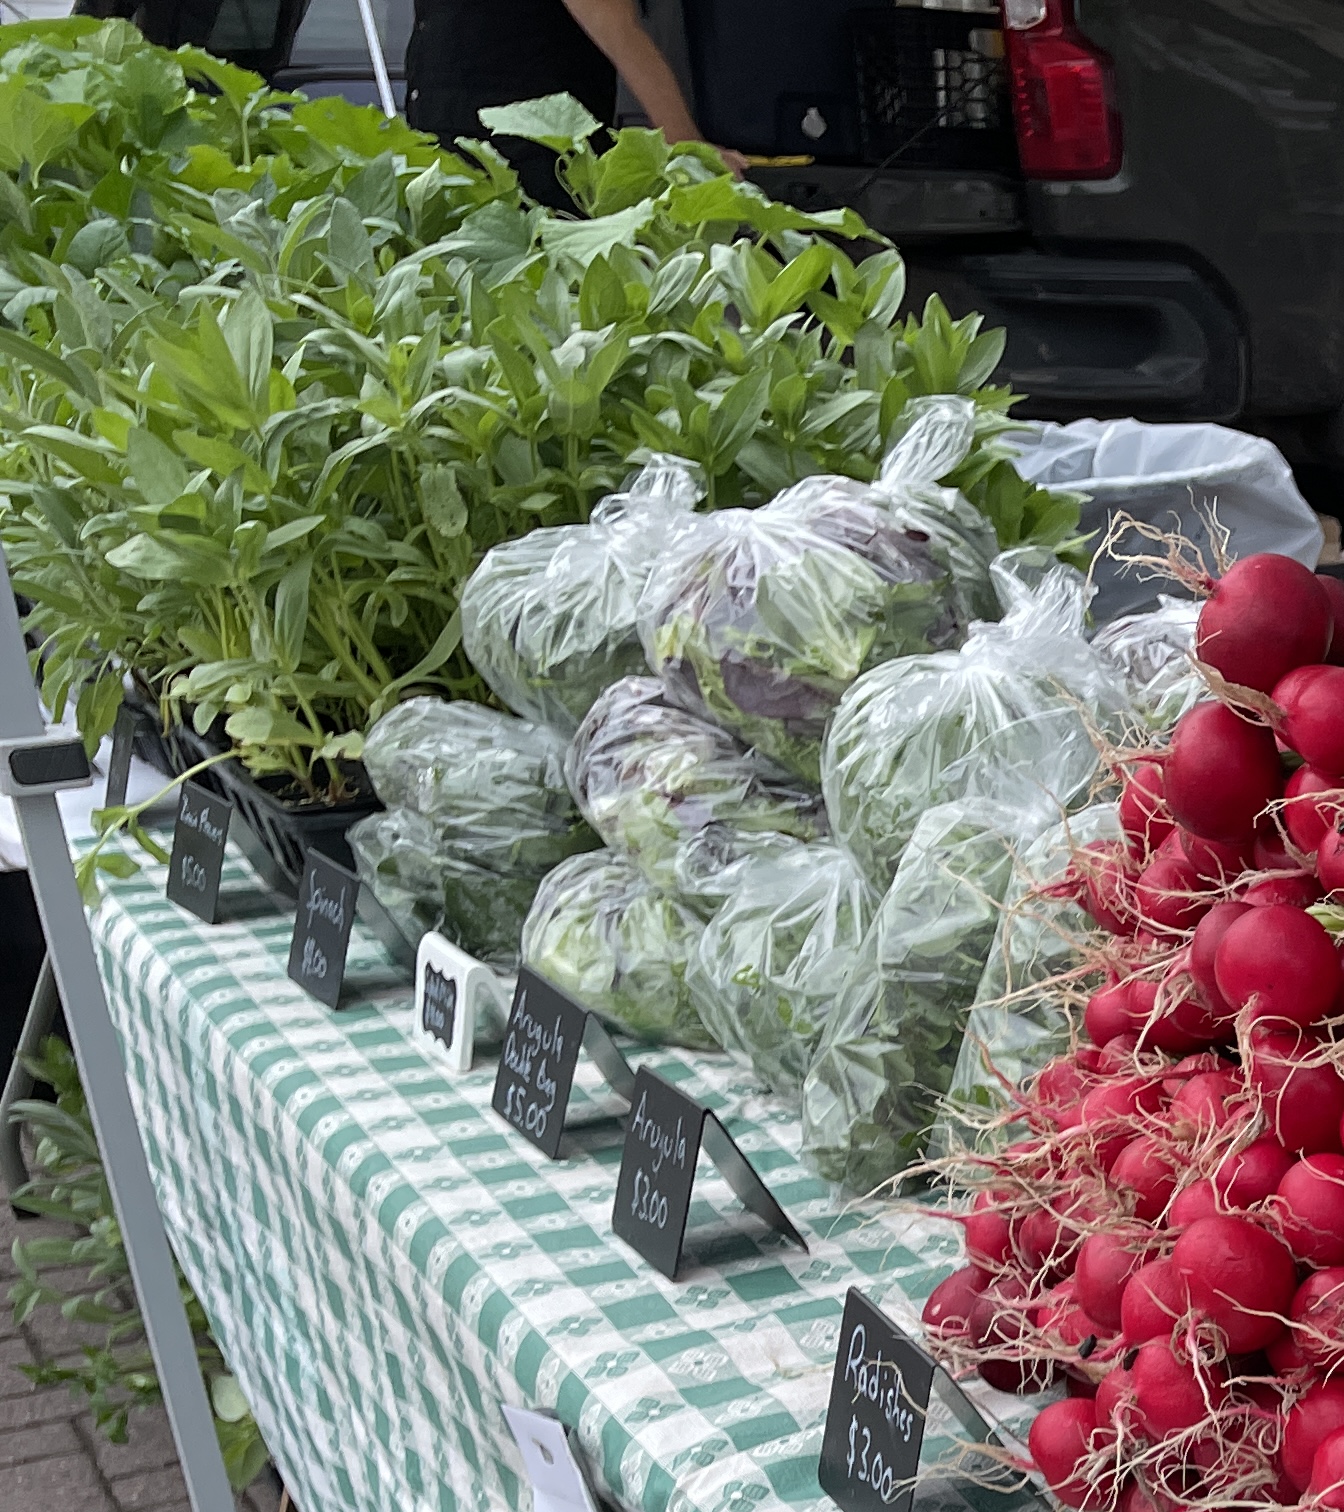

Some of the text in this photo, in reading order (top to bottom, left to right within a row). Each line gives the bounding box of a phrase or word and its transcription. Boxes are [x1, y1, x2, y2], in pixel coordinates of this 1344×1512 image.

[513, 989, 564, 1063] Arugula
[503, 1082, 547, 1139] $5.00
[631, 1089, 687, 1172] Arugula
[631, 1167, 668, 1230] $3.00
[844, 1323, 914, 1443] Radishes
[846, 1413, 893, 1504] $3.00
